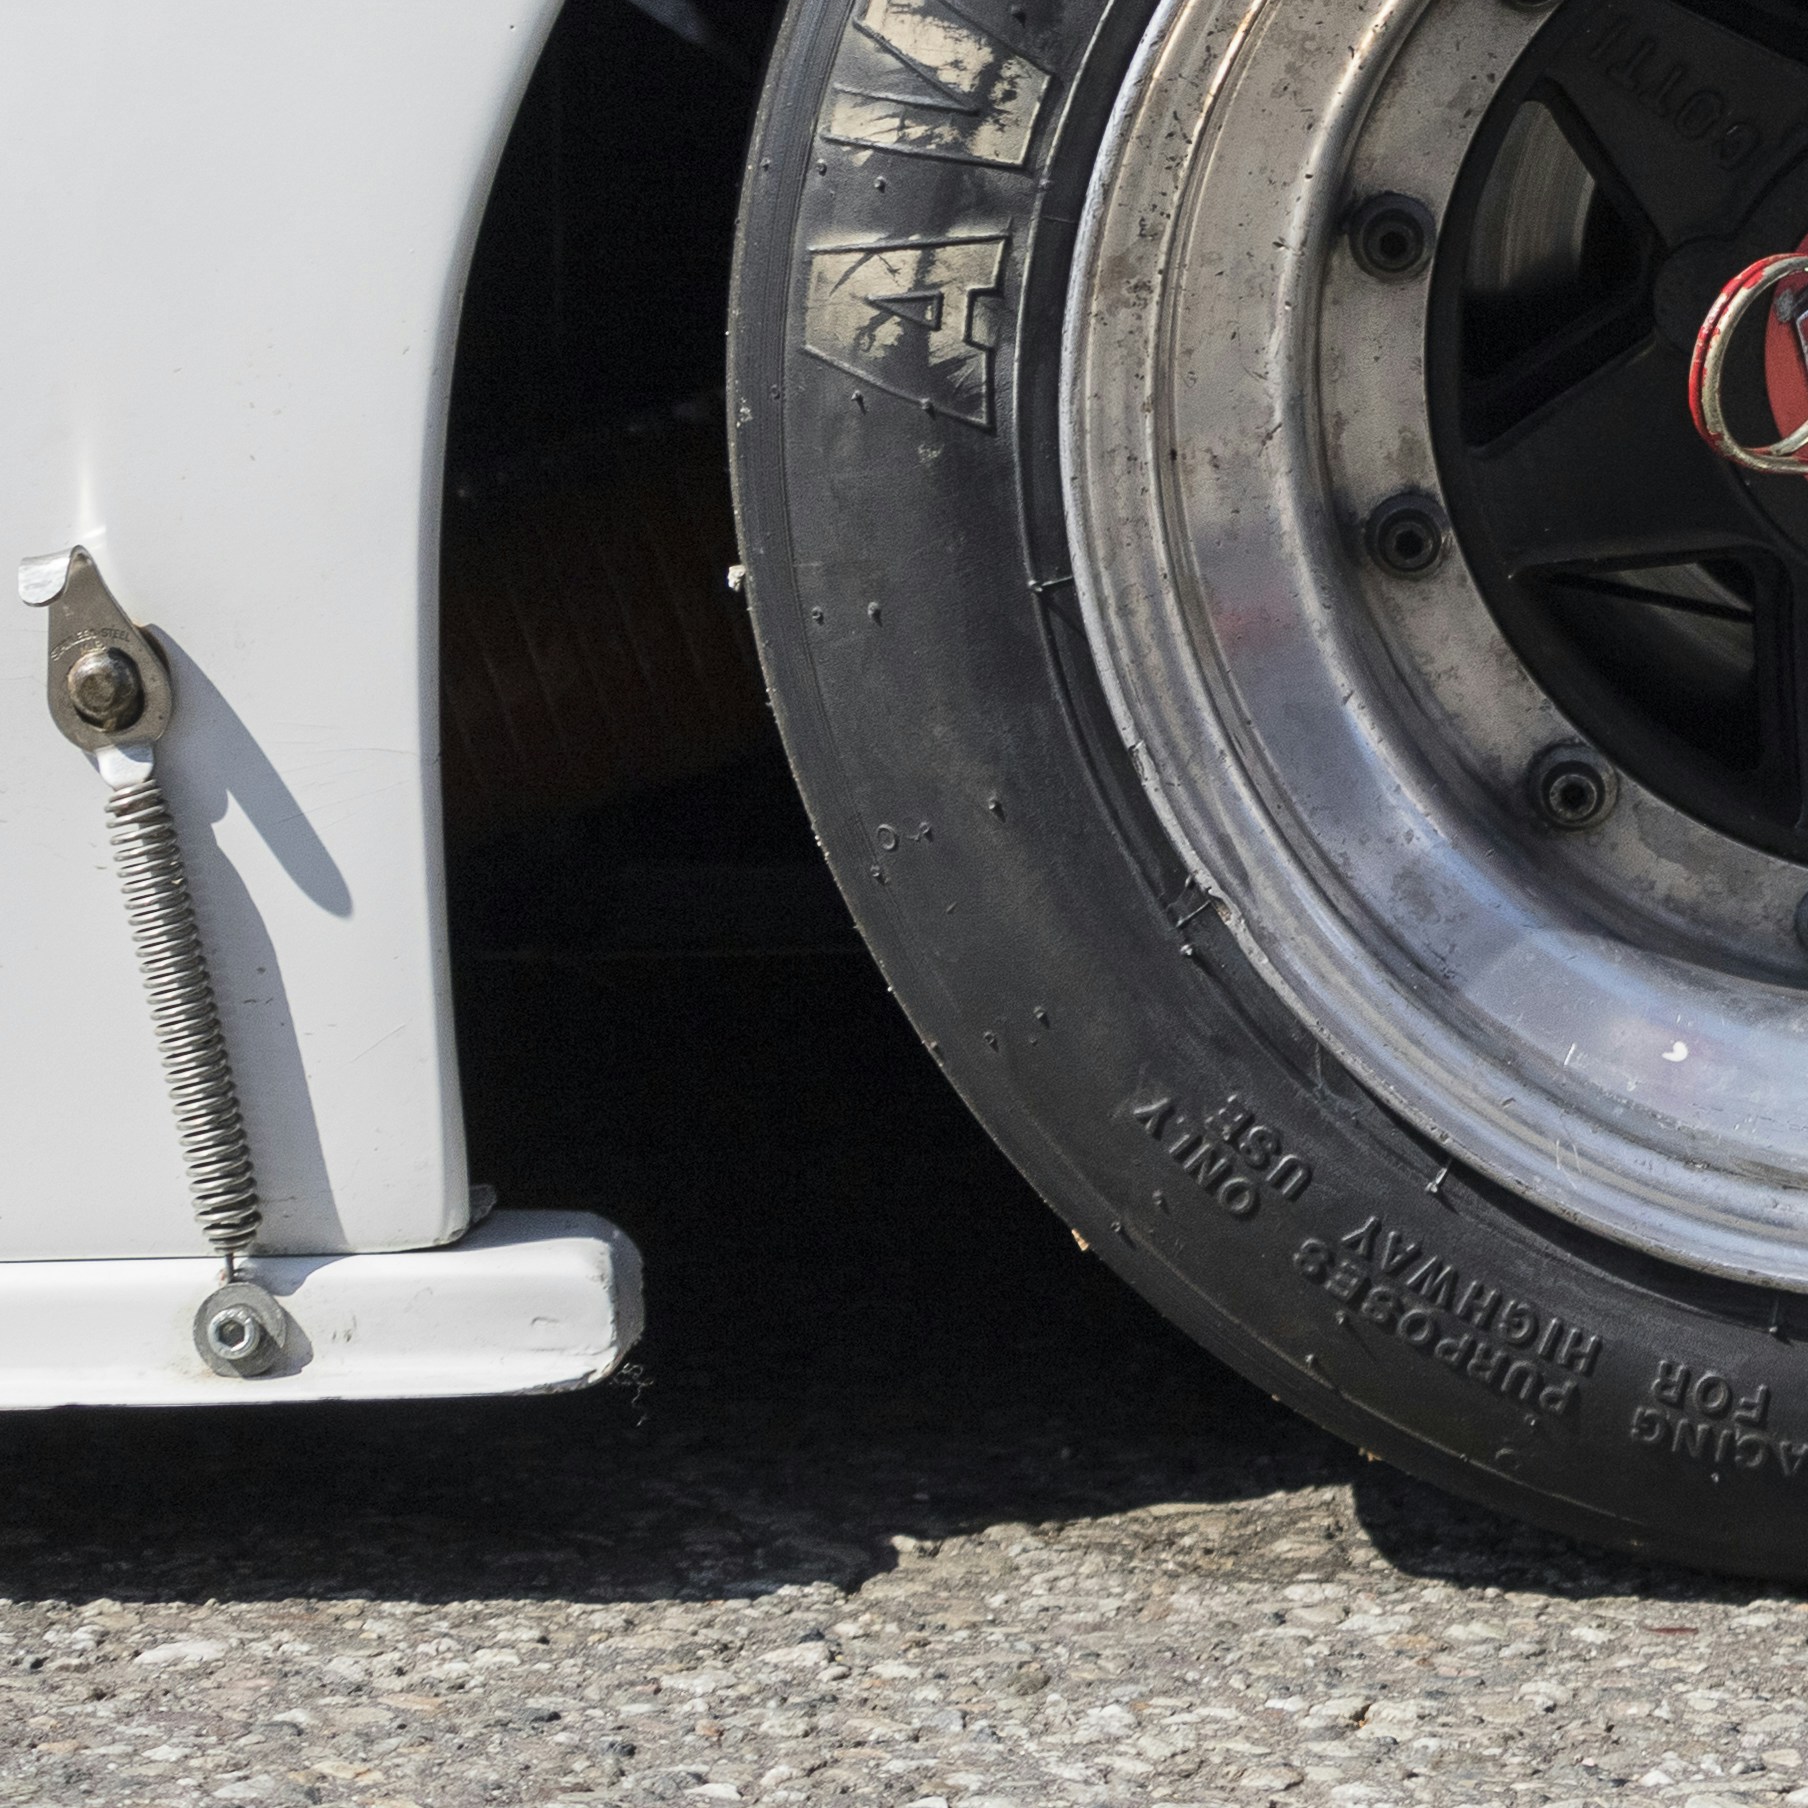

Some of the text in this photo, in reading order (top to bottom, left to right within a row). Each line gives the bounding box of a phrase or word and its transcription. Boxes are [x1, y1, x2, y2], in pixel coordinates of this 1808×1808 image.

[1132, 1096, 1255, 1216] ONLY
[1205, 1093, 1312, 1199] USE
[1293, 1236, 1578, 1416] PURPOSES
[1341, 1213, 1602, 1377] HIGHWAY
[1650, 1359, 1772, 1427] FOR
